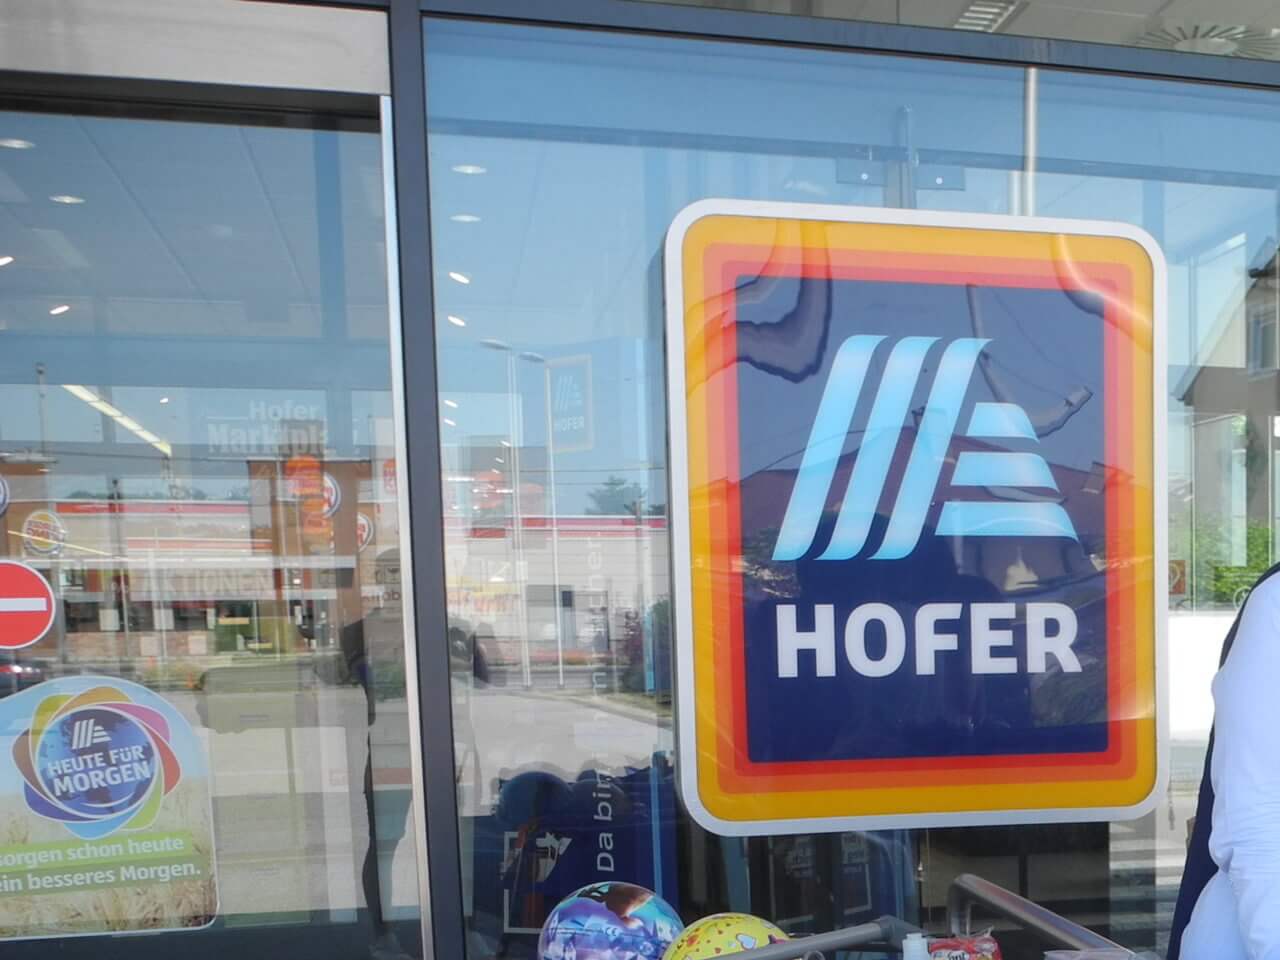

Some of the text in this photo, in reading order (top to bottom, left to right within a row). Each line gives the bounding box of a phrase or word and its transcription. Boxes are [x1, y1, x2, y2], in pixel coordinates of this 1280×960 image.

[248, 399, 323, 421] Hofer
[775, 602, 1083, 679] HOFER
[47, 744, 146, 778] HEUTE FÜR
[53, 760, 152, 797] MORGEN
[68, 842, 124, 860] schon
[128, 837, 185, 854] heute
[595, 832, 615, 873] Da
[27, 868, 116, 891] besseres
[119, 862, 202, 882] Morgen.
